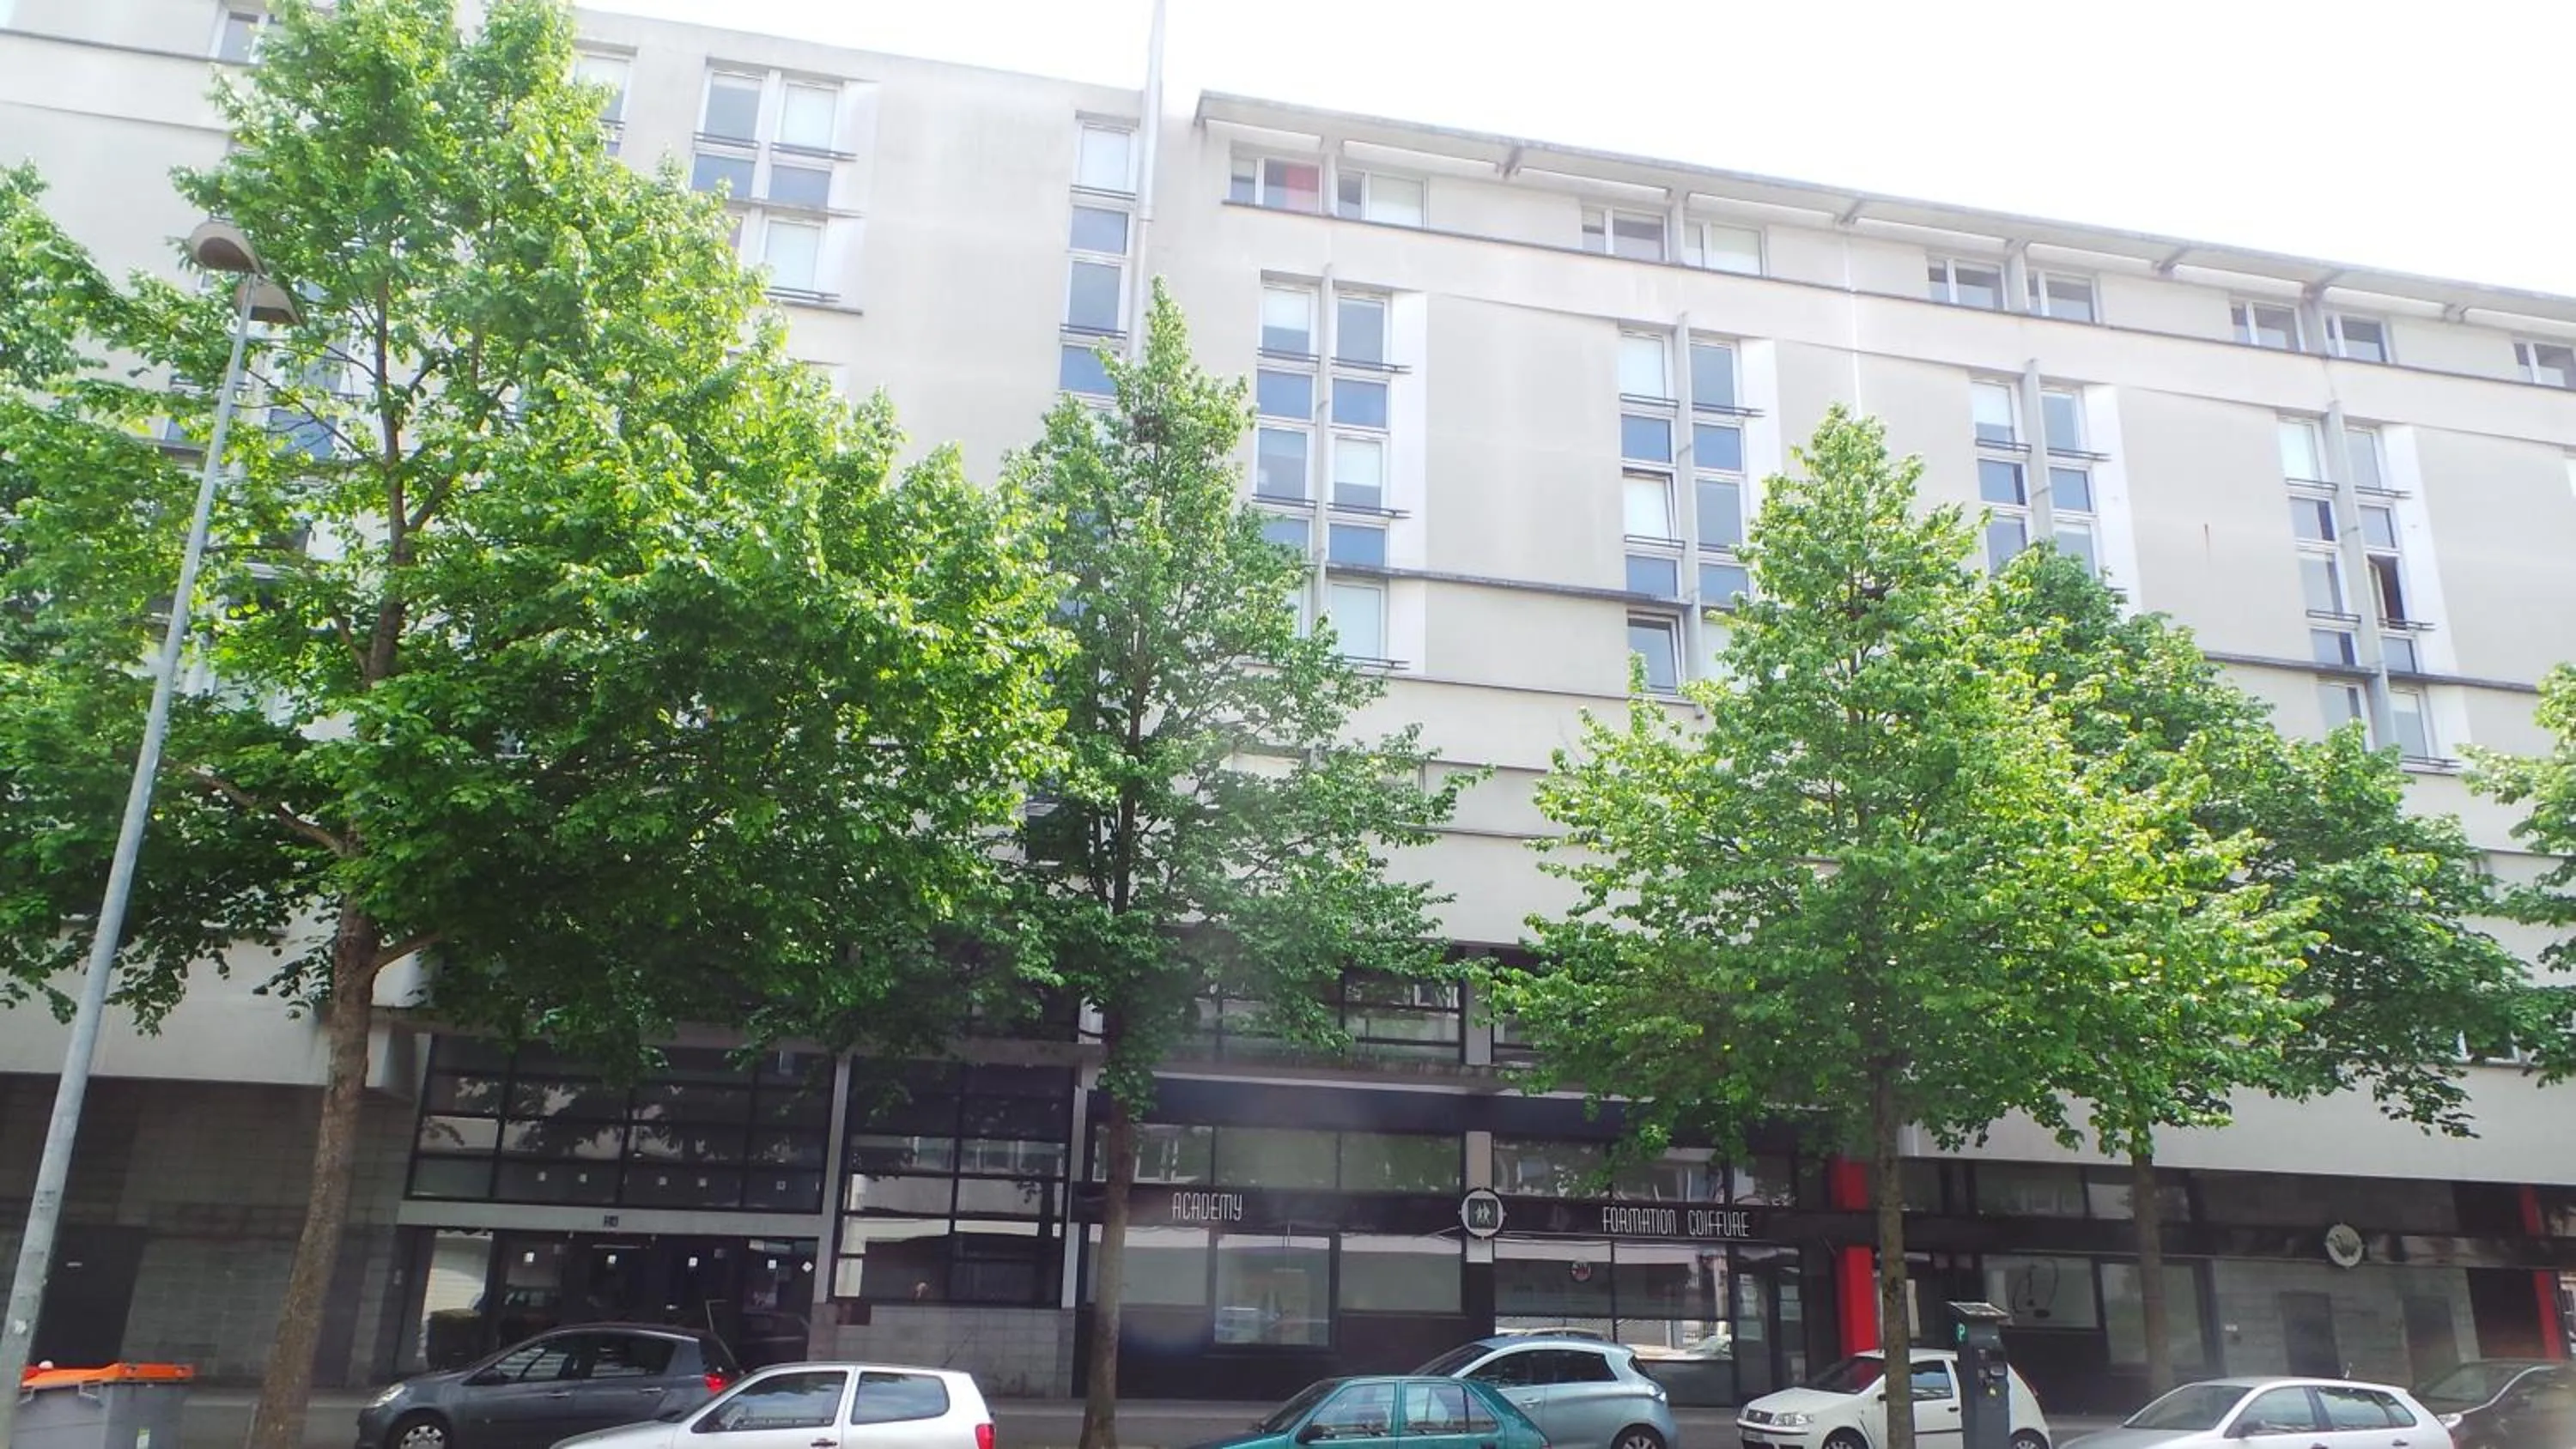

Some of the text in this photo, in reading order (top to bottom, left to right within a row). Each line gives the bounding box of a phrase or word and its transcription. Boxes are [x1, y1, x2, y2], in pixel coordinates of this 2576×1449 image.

[1172, 1192, 1242, 1221] ACADEMY
[1602, 1206, 1750, 1237] FORMATION COIFFURE
[1957, 1323, 1965, 1341] P
